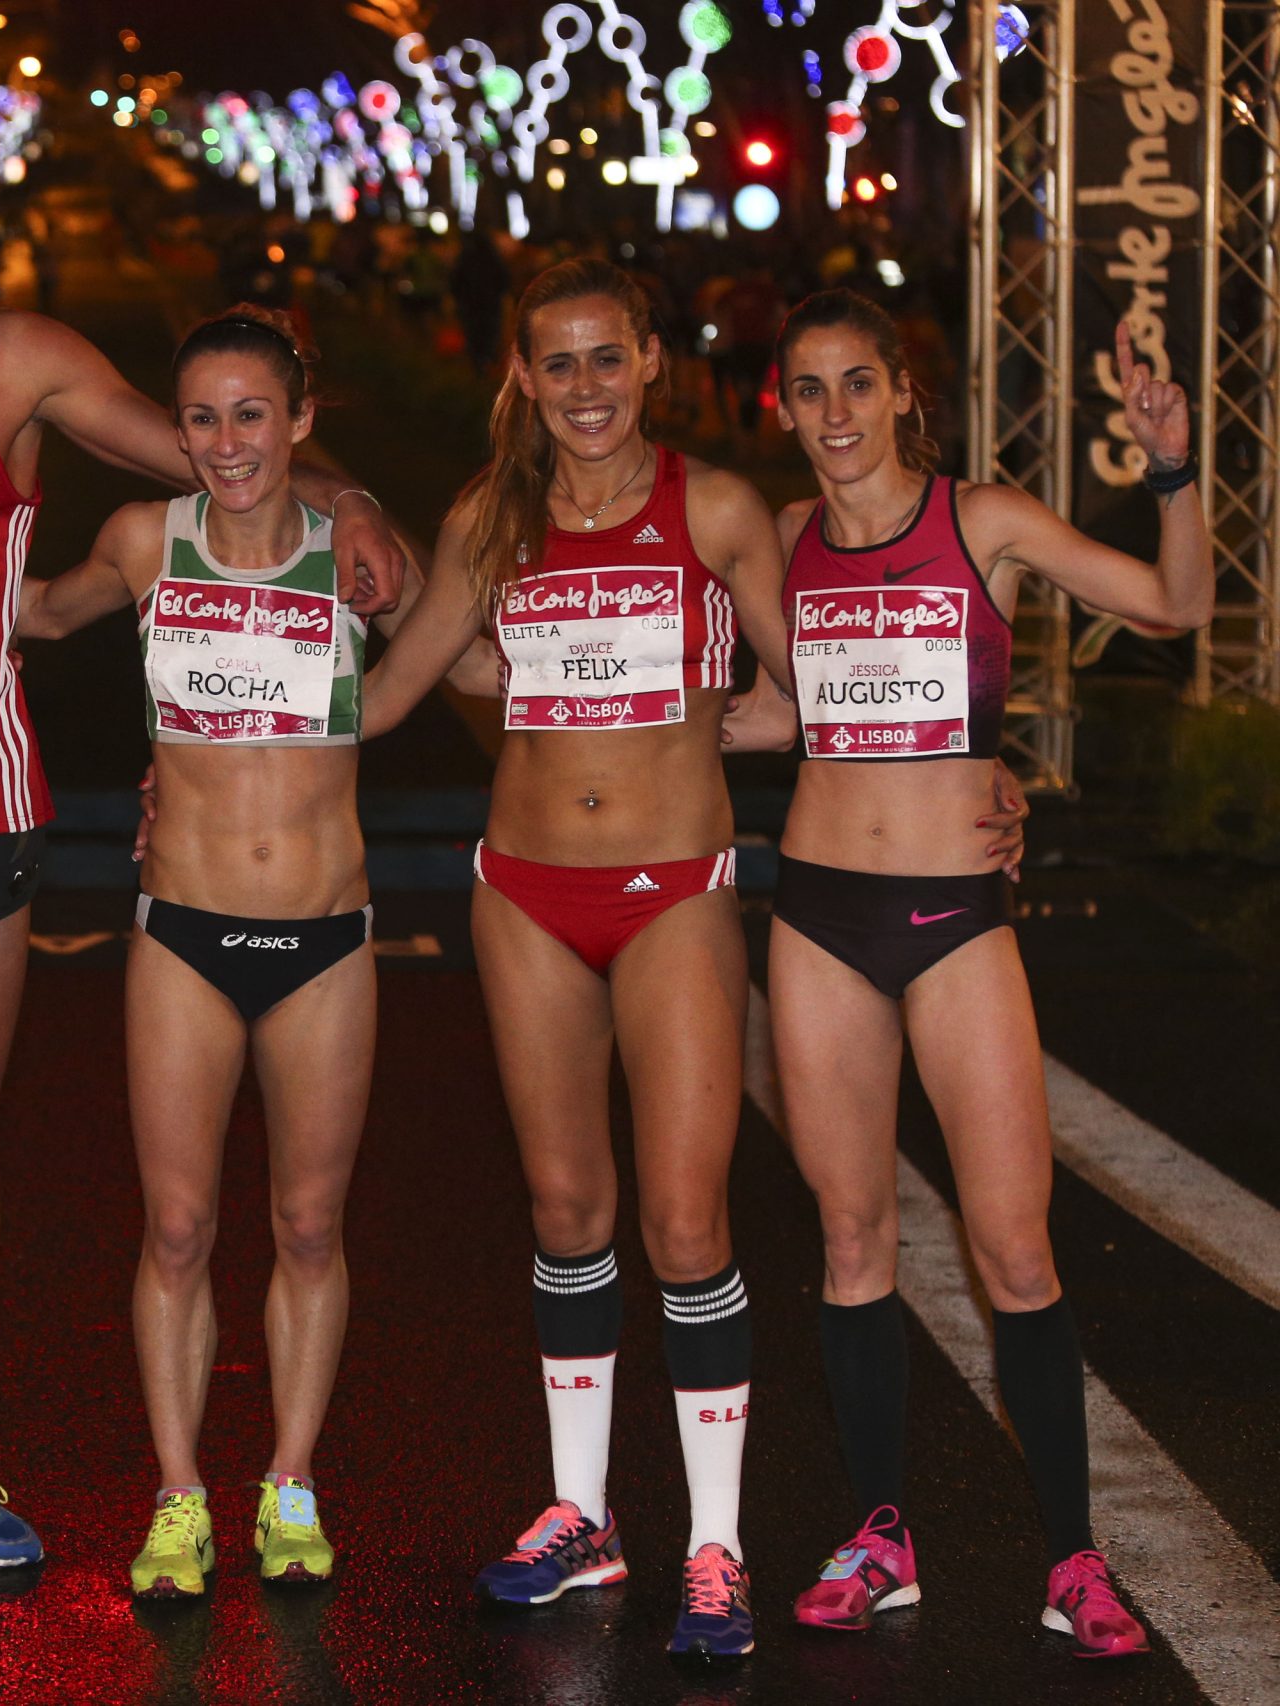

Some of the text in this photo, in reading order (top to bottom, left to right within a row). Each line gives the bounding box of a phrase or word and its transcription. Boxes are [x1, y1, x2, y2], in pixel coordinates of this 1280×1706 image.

[633, 535, 664, 544] adidas
[528, 586, 585, 612] Corte
[588, 574, 674, 617] Inglés
[159, 589, 329, 635] El Corte Inglés
[801, 593, 959, 637] El Corte Inglés
[641, 617, 678, 630] 0001
[153, 628, 211, 645] ELITE A
[503, 625, 561, 640] ELITE A
[294, 641, 331, 657] 0007
[569, 643, 613, 655] DULCE
[796, 642, 847, 657] ELITE A
[925, 639, 962, 652] 0003
[215, 657, 262, 673] CARLA
[561, 654, 627, 680] FÉLIX
[849, 662, 900, 677] JÉSSICA
[187, 670, 288, 702] ROCHA
[816, 679, 944, 705] AUGUSTO
[576, 701, 634, 718] LISBOA
[218, 711, 277, 730] LISBOA
[858, 729, 917, 745] LISBOA
[623, 882, 660, 893] adidas
[246, 936, 300, 949] asics
